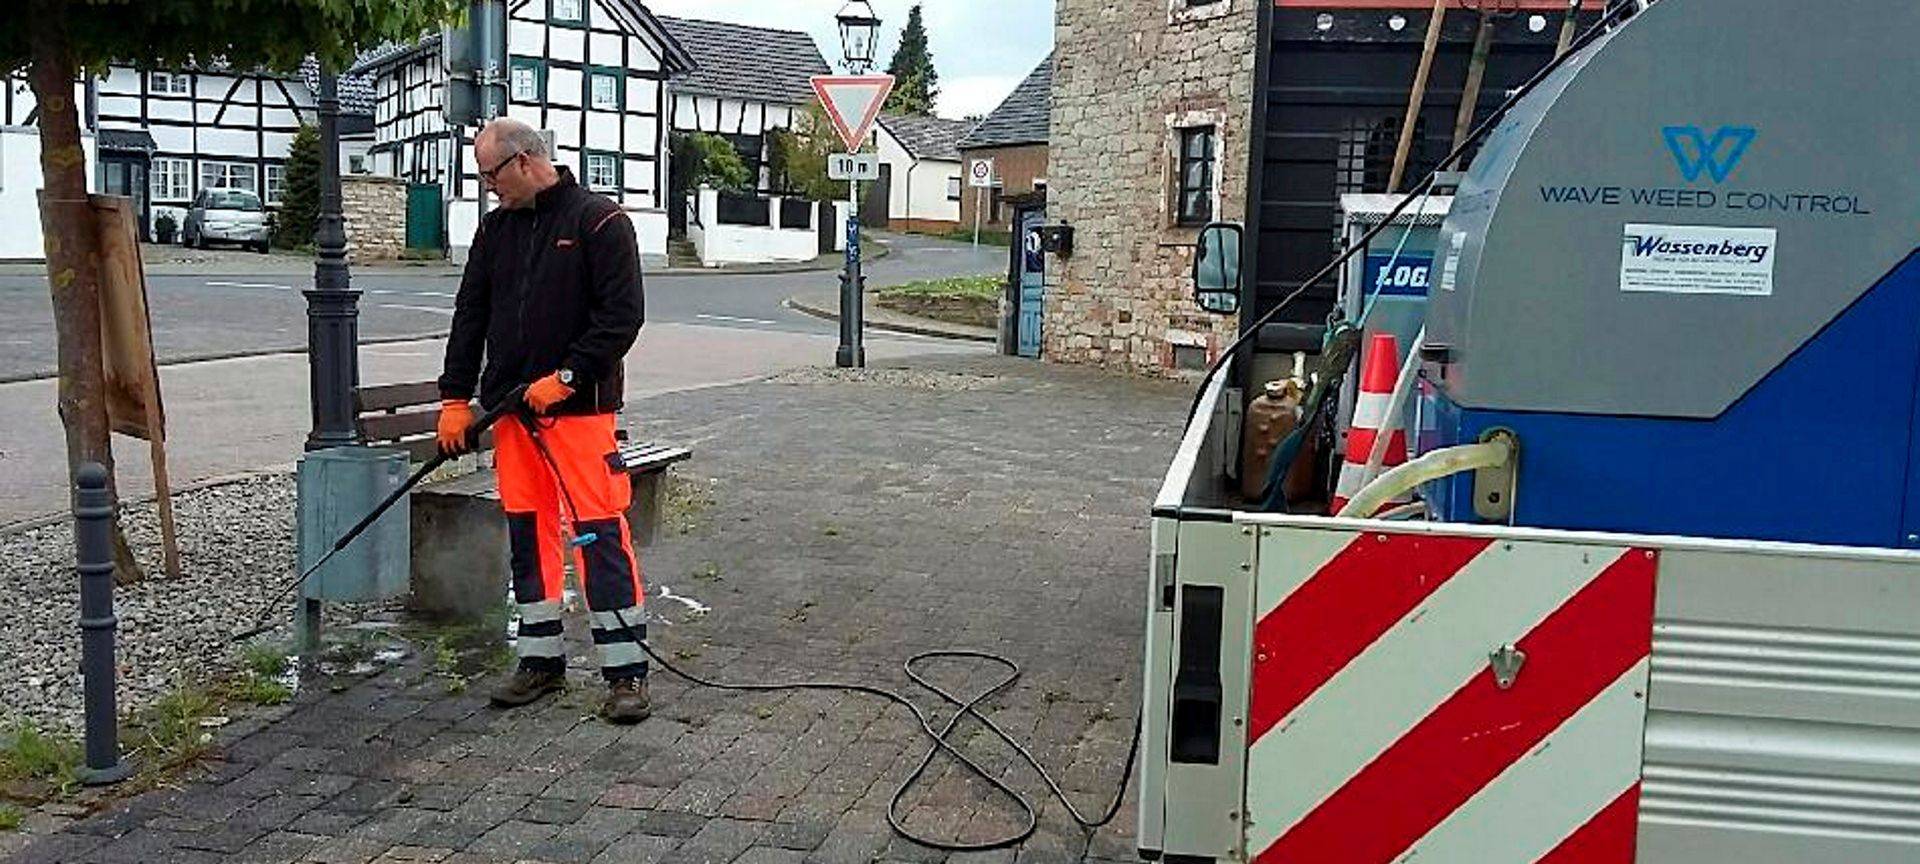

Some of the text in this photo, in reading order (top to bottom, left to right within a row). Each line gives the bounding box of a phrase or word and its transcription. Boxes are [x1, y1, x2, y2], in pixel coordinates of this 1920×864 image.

[838, 158, 853, 174] 10
[1540, 186, 1871, 215] WAVE WEED CONTROL
[1633, 235, 1769, 263] Wassenberg
[1376, 265, 1429, 287] LOG
